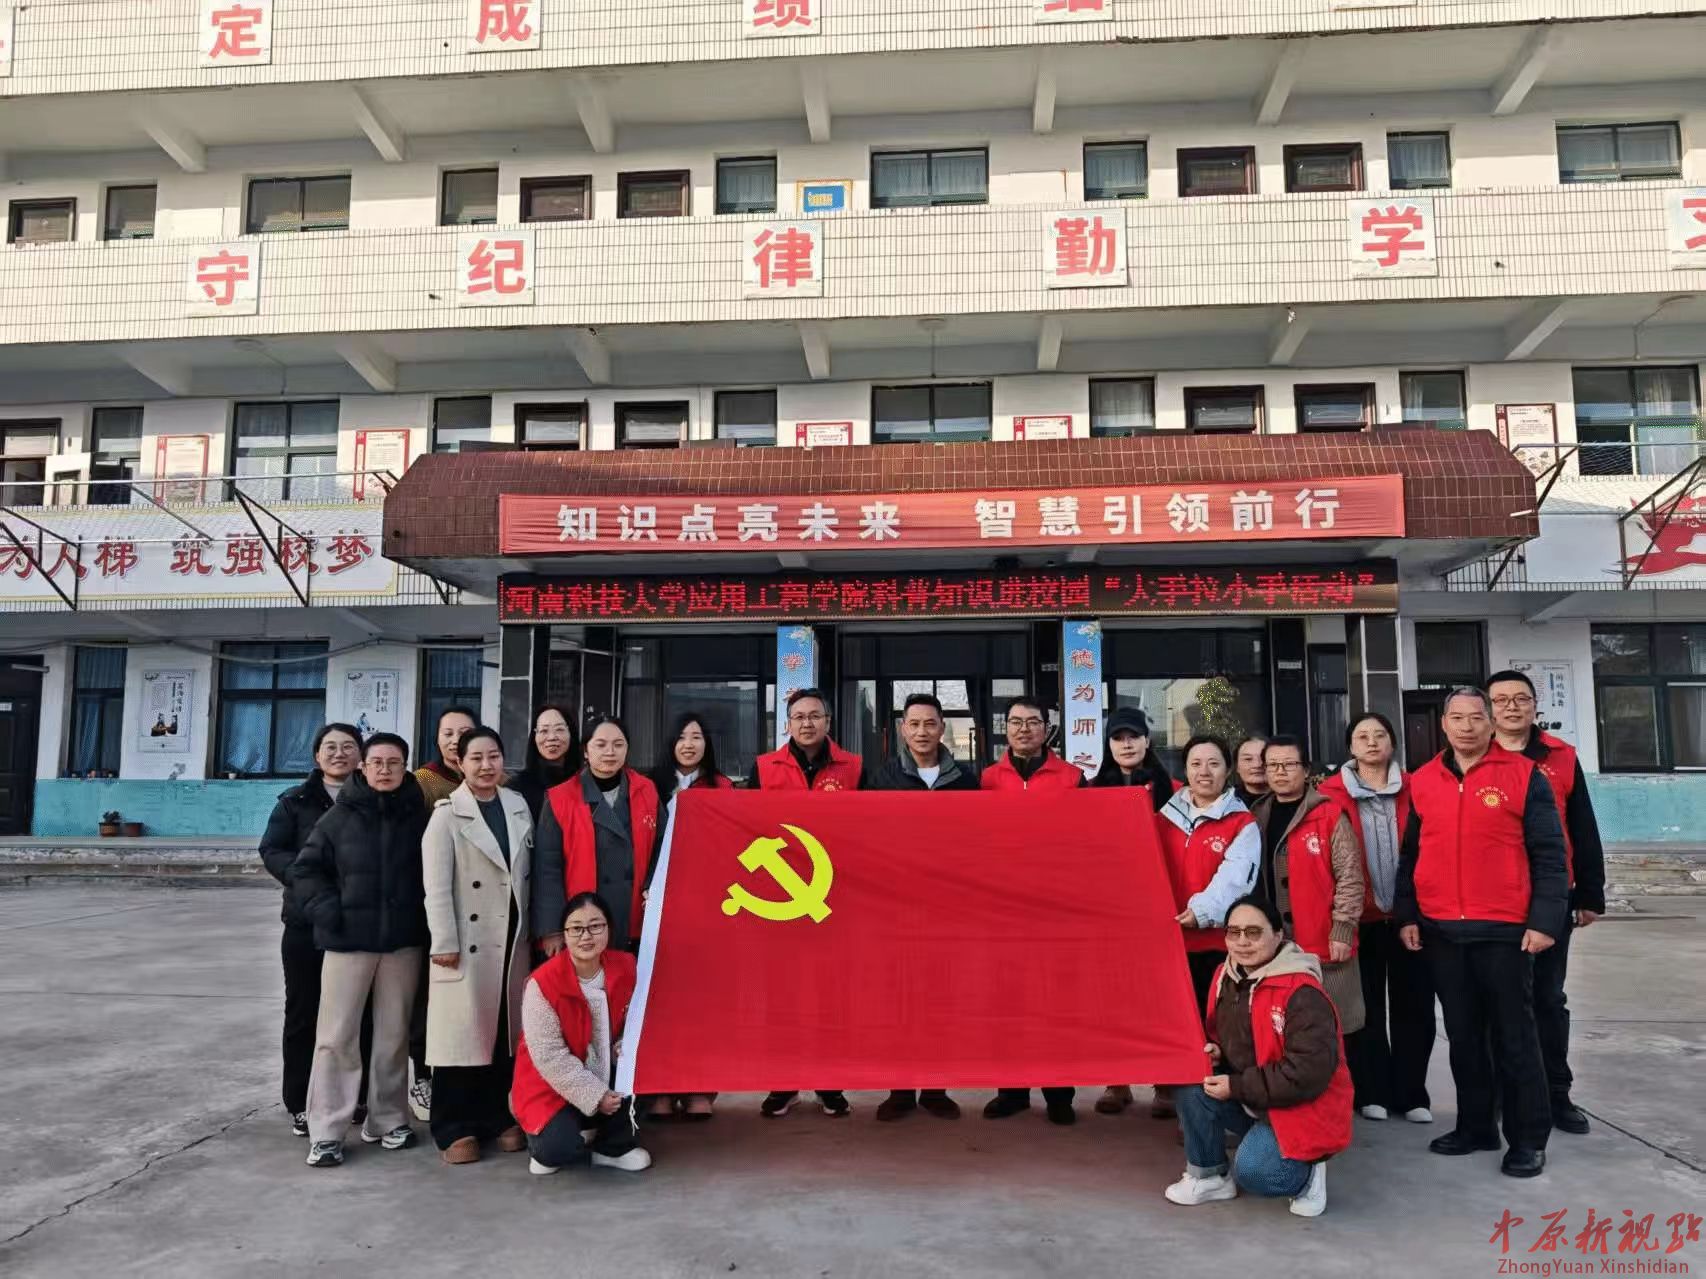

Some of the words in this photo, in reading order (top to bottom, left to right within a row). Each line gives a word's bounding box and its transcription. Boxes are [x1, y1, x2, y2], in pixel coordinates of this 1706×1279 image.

[557, 503, 901, 542] 知识点亮未来
[974, 489, 1340, 538] 智慧引领前行
